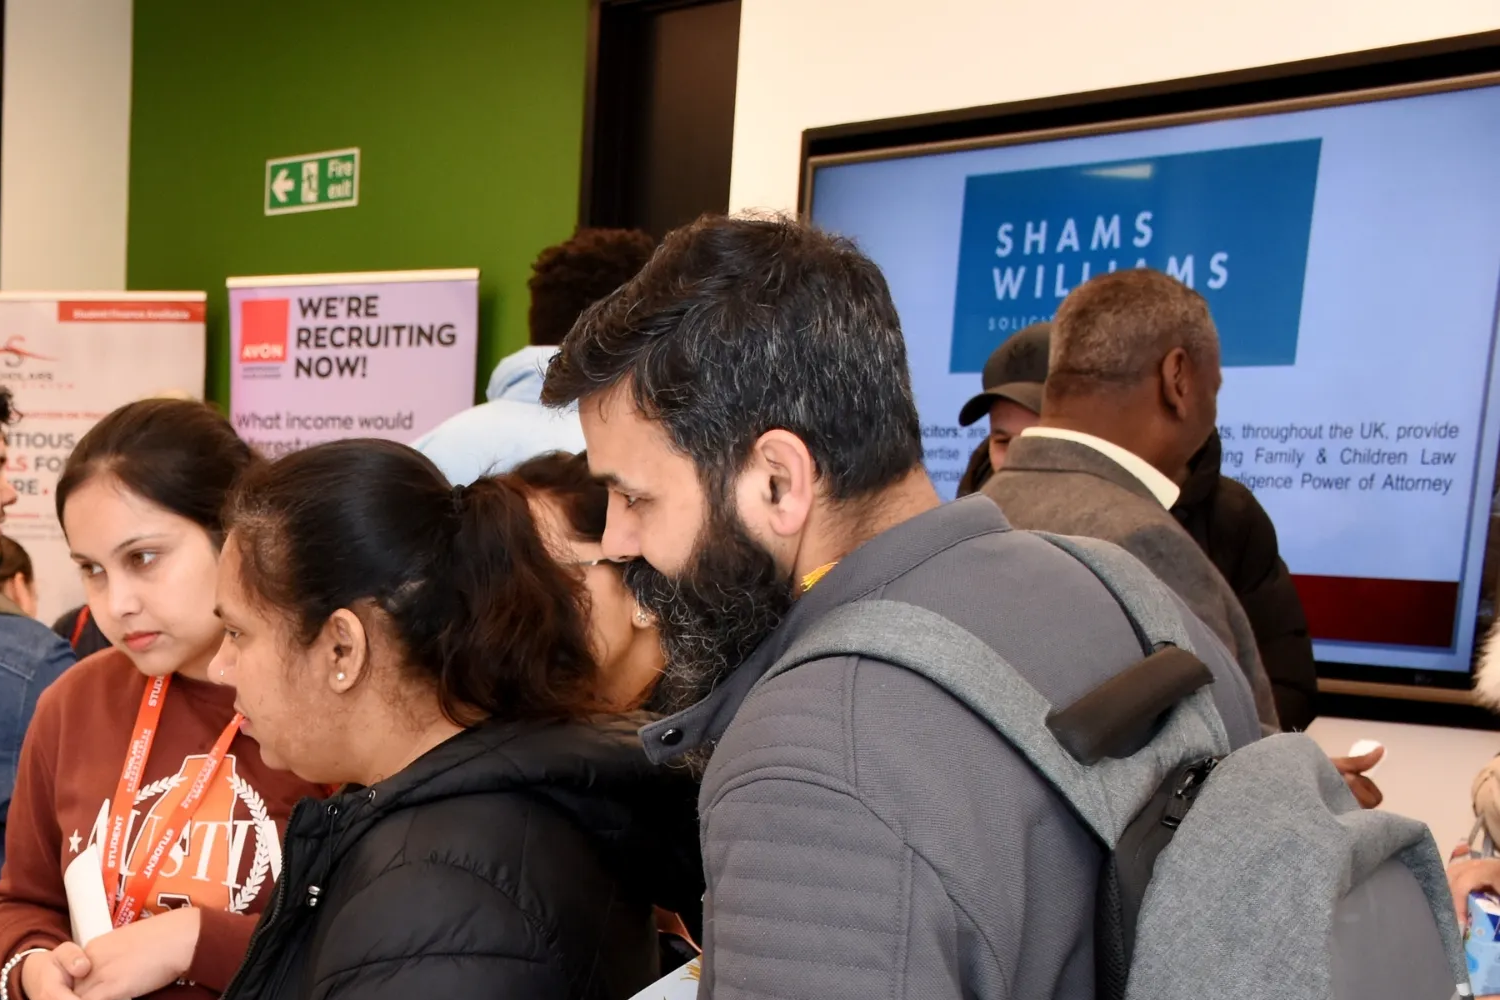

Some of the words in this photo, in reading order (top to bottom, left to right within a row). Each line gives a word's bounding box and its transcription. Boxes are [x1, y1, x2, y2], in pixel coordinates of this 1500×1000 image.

[328, 159, 353, 179] Fire
[327, 179, 352, 199] exit
[995, 211, 1153, 258] SHAMS
[993, 252, 1229, 300] WILMS
[298, 296, 379, 319] WE'RE
[296, 324, 457, 349] RECRUITING
[242, 344, 283, 359] AVON
[295, 356, 367, 379] NOW!
[285, 413, 354, 430] income
[358, 412, 414, 430] would
[1242, 422, 1323, 443] throughout
[1329, 422, 1353, 439] the
[1395, 421, 1459, 443] provide
[1254, 447, 1304, 467] Family
[1316, 448, 1327, 465] &
[1340, 447, 1408, 465] Children
[1420, 448, 1456, 466] Law
[1301, 473, 1351, 491] Power
[1358, 473, 1376, 491] of
[1382, 473, 1453, 496] Attorney
[107, 815, 124, 869] STUDENT
[143, 828, 175, 879] STUDENT
